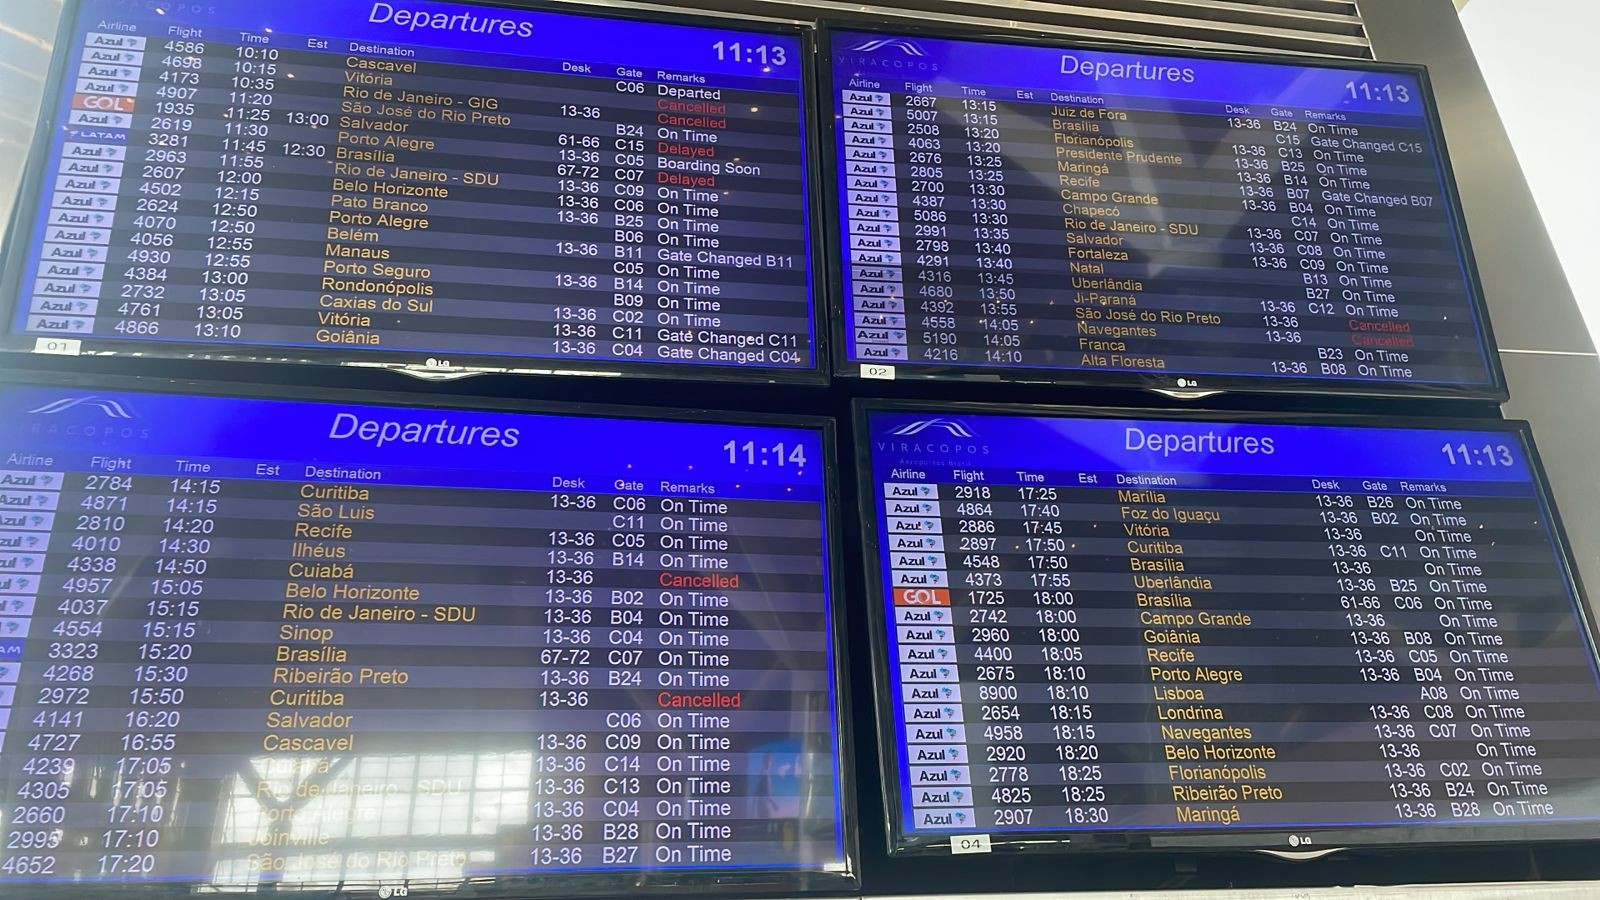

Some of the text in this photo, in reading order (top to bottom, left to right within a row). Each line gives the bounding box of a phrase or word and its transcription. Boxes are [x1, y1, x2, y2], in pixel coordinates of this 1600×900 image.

[367, 2, 533, 38] Departures
[98, 20, 705, 83] Airline Flight Time Est Destination Desk Gate Remarks
[712, 41, 786, 66] 11:13
[837, 56, 938, 71] VIRACOPOS
[1061, 55, 1195, 83] Departures
[849, 79, 1345, 121] Airline Flight Time Est Destination Desk Gate Remarks
[1345, 81, 1409, 102] 11:13
[83, 95, 714, 158] GOL 1935 11:25 13:00 Salvador 61-66 C15 Delayed
[81, 131, 715, 187] LATAM 3281 11:45 12:30 Brasília 67-72 C07 Delayed
[852, 135, 1367, 176] Azul 4063 13:20 Presidente Prudente 13-36 B25 On Time
[861, 300, 1410, 333] Azul 4392 13:55 São José do Rio Preto 13-36 Cancelled
[36, 320, 798, 363] Azul 4866 13:10 Goiânia 13-36 C04 Gate Changed C04
[47, 342, 67, 351] 01
[869, 367, 886, 376] 02
[329, 412, 520, 448] Departures
[1125, 428, 1275, 457] Departures
[723, 441, 806, 467] 11:14
[878, 442, 989, 454] VIRACOPOS
[1442, 443, 1514, 467] 11:13
[7, 454, 715, 495] Airline Flight Time Est Destination Desk Gate Remarks
[890, 468, 1446, 493] Airline Flight Time Est Destination Desk Gate Remarks
[893, 503, 1467, 526] Azul 4864 17:40 Foz do Iguaçu 13-36 B02 On Time
[903, 589, 1492, 611] GOL 1725 18:00 Brasília 61-66 C06 On Time
[43, 666, 729, 687] 4268 15:30 Ribeirão Preto 13-36 B24 On Time
[911, 685, 1519, 700] Azul 8900 18:10 Lisboa A08 On Time
[28, 734, 730, 753] 4727 16:55 Cascavel 13-36 C09 On Time
[923, 801, 1553, 825] Azul 2907 18:30 Maringá 13-36 B28 On Time
[961, 838, 980, 850] 04
[2, 845, 731, 874] 4652 17:20 13-36 B27 On Time
